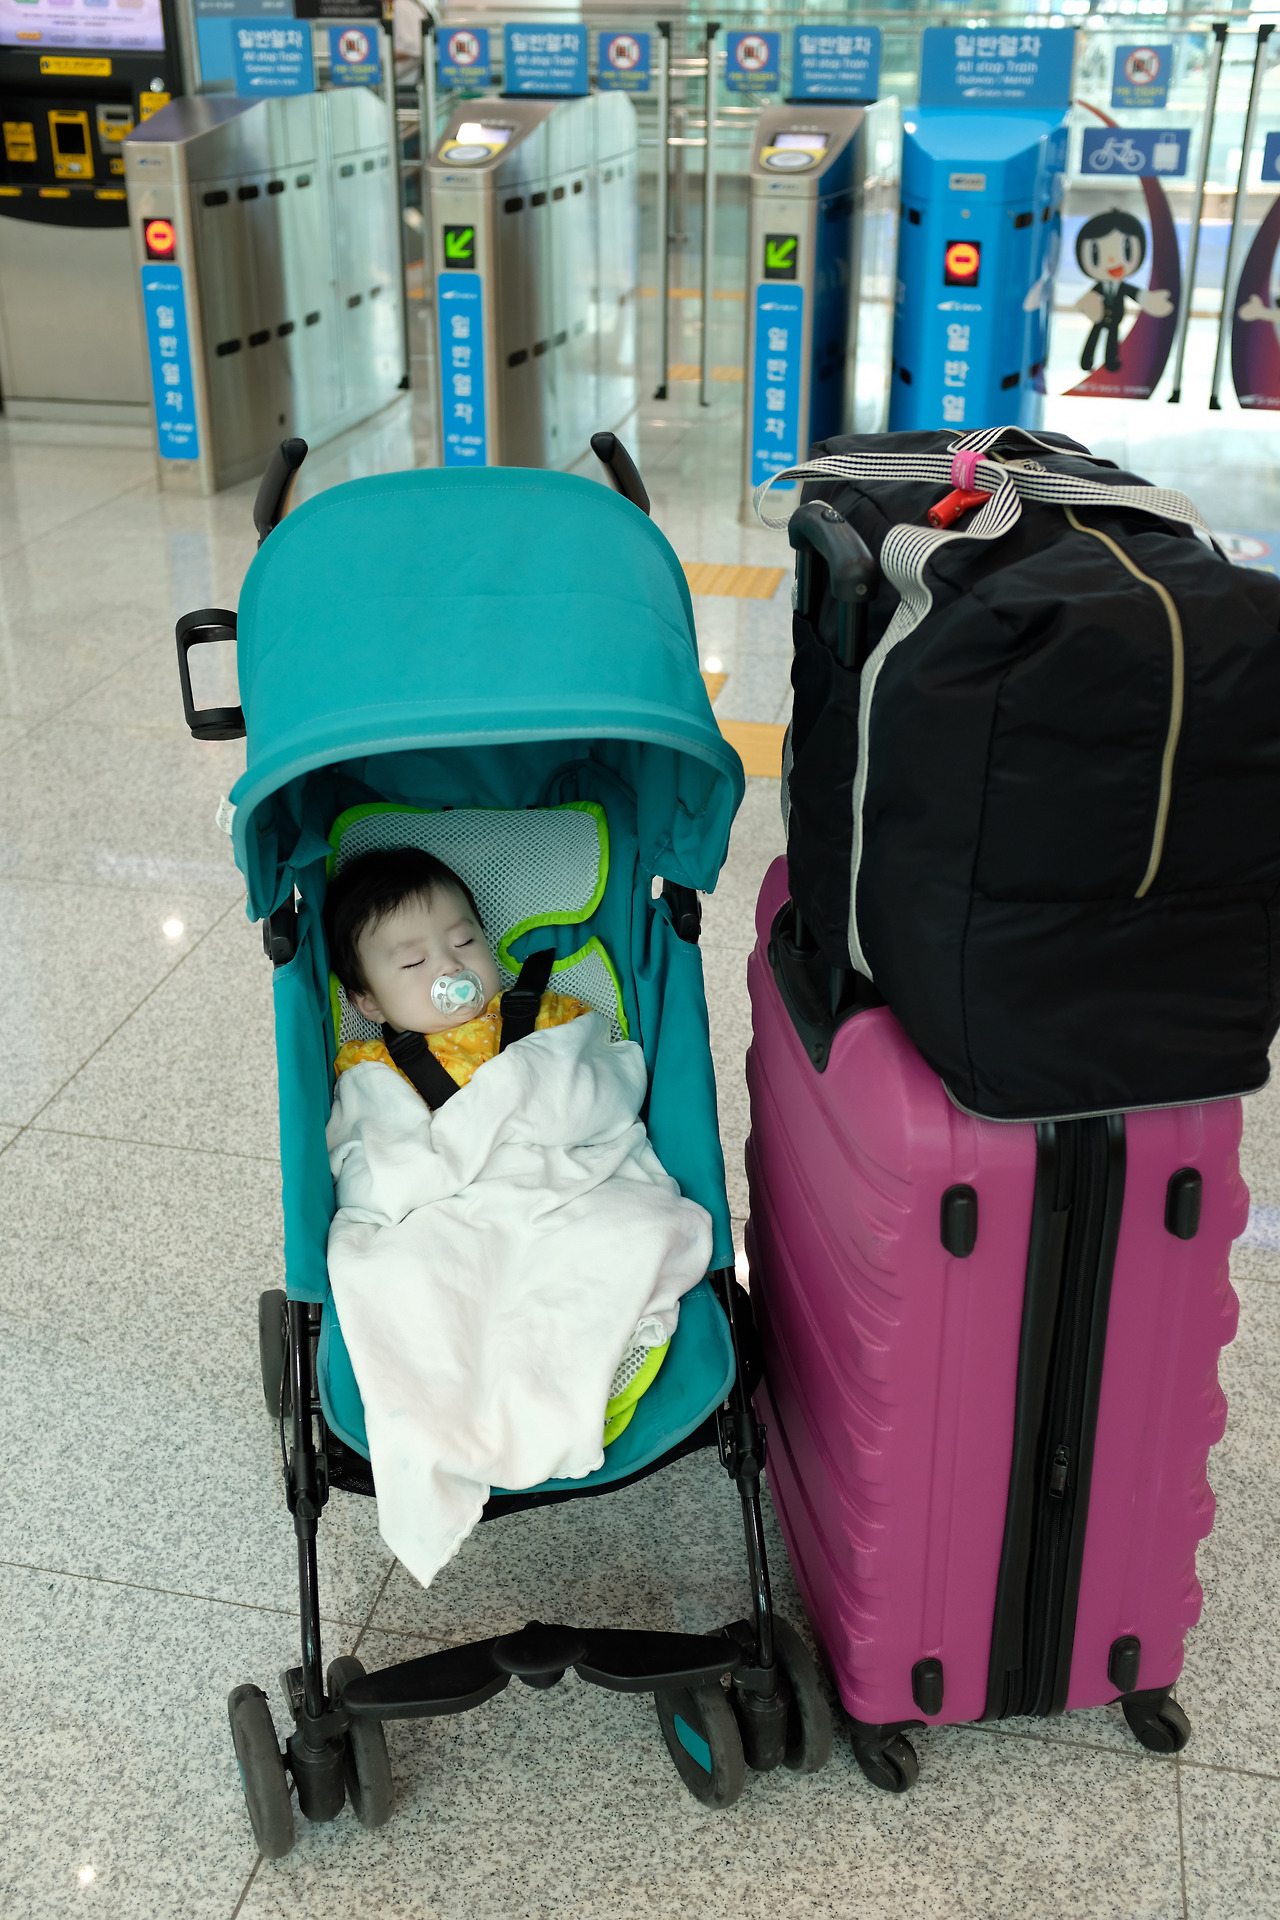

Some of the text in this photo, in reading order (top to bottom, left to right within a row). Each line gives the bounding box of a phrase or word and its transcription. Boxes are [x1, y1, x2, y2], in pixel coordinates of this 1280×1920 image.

[238, 29, 303, 49] 일반열차
[510, 32, 580, 52] 일반열차
[799, 34, 872, 55] 일반열차
[955, 35, 1042, 57] 일반열차
